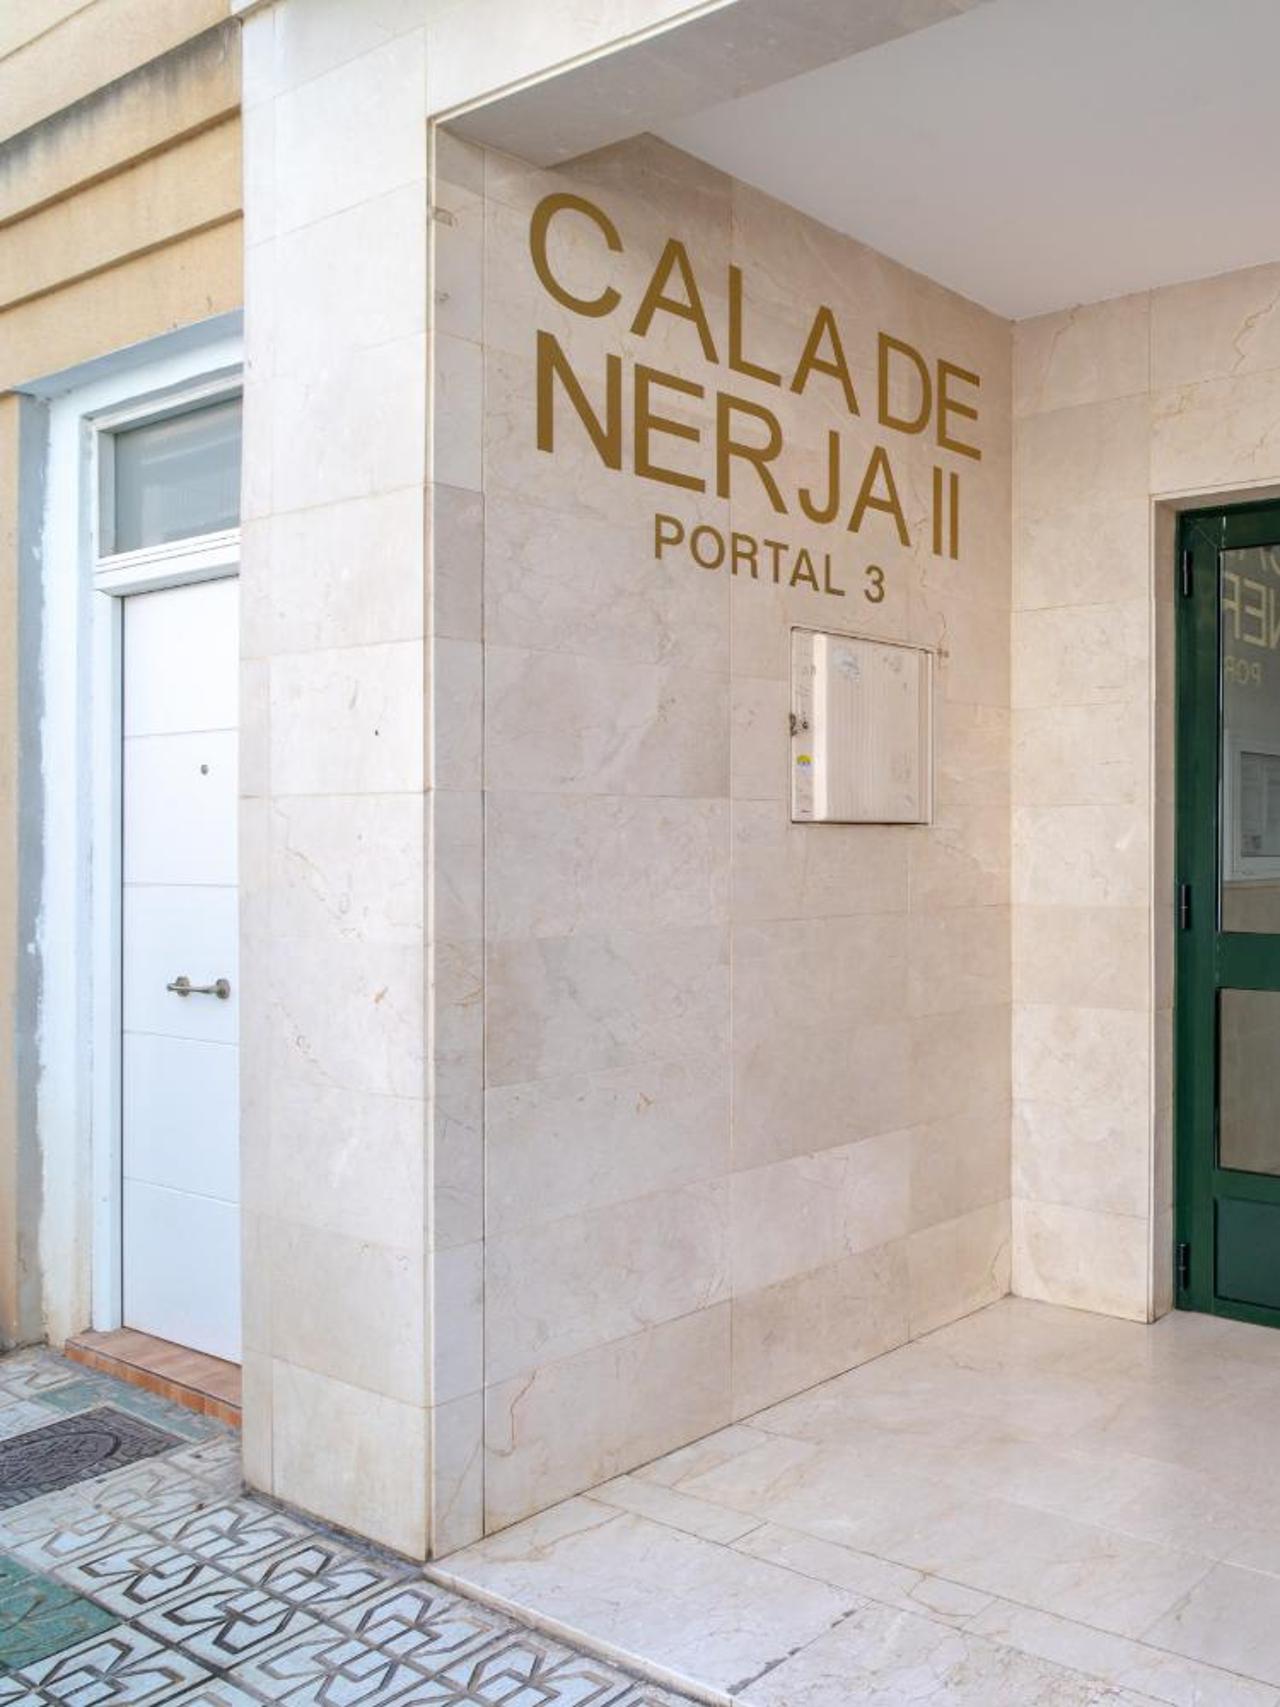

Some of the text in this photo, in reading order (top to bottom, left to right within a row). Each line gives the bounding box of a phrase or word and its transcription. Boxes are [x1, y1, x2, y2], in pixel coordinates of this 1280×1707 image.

[530, 193, 982, 461] CALA DE
[536, 329, 959, 560] NERJA II
[654, 513, 885, 603] PORTAL 3
